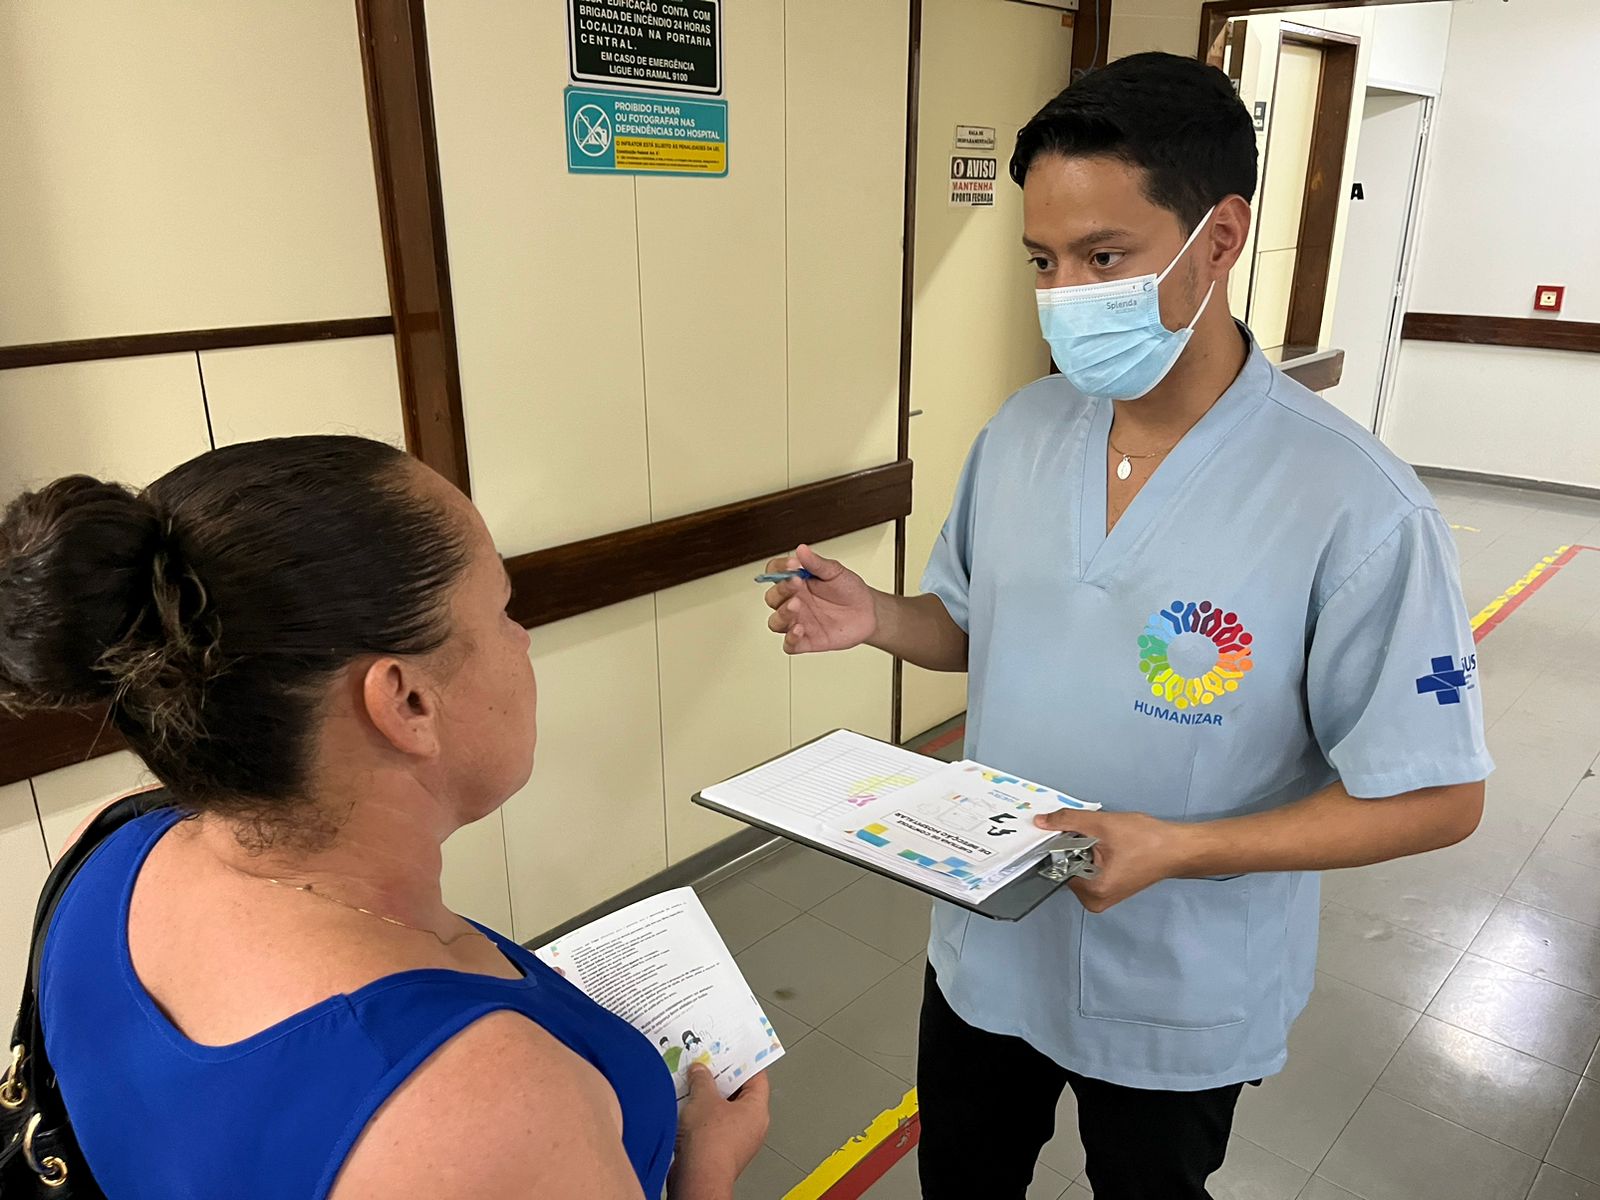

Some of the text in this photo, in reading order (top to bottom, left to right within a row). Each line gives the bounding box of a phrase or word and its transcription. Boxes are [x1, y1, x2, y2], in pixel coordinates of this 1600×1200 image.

[579, 4, 711, 34] BRIGADA DE INCÊNDIO 24 HORAS
[662, 4, 689, 18] CONTA
[693, 9, 711, 21] COM
[580, 19, 712, 47] LOCALIZADA NA PORTARIA
[580, 33, 637, 50] CENTRAL.
[600, 51, 695, 71] EM CASO DE EMERGÊNCIA
[609, 65, 688, 82] LIGUE NO RAMAL 9100
[614, 101, 681, 115] PROIBIDO FILMAR
[615, 113, 695, 128] OU FOTOGRAFAR NAS
[615, 123, 720, 140] DEPENDÊNCIAS DO HOSPITAL
[966, 159, 995, 178] AVISO
[952, 181, 993, 191] MANTENHA
[1106, 299, 1137, 310] Splenda
[1134, 699, 1224, 727] HUMANIZAR
